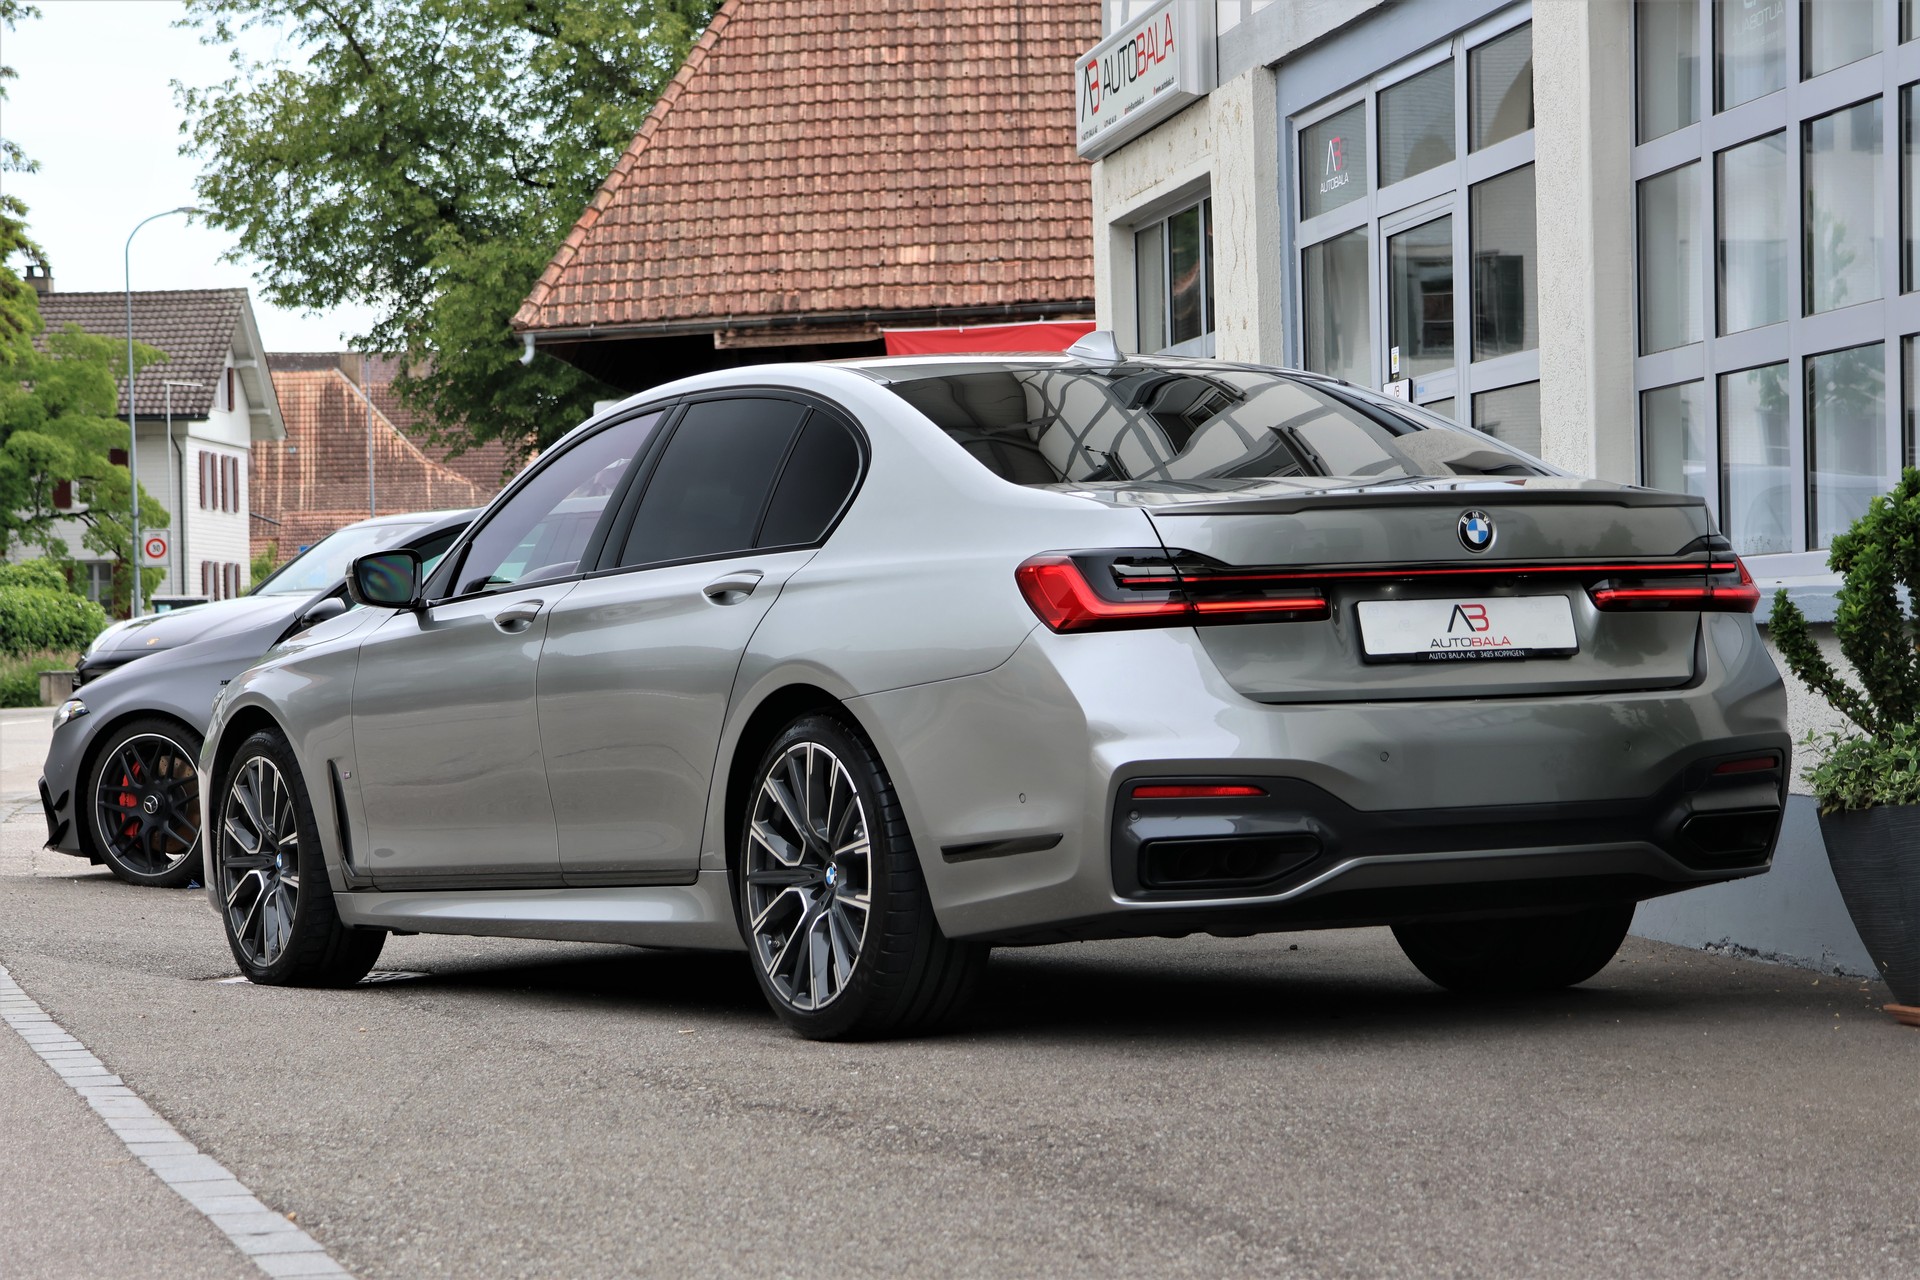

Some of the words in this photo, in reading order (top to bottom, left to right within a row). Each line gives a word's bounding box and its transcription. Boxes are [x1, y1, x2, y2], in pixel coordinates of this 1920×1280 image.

[1102, 12, 1175, 101] AUTOBALA
[1320, 172, 1349, 194] AUTOBALA
[1447, 604, 1490, 633] AB
[1430, 636, 1511, 649] AUTOBALA
[1429, 652, 1447, 660] AUTO
[1466, 651, 1476, 659] AG
[1494, 649, 1525, 657] KOPPIGEN
